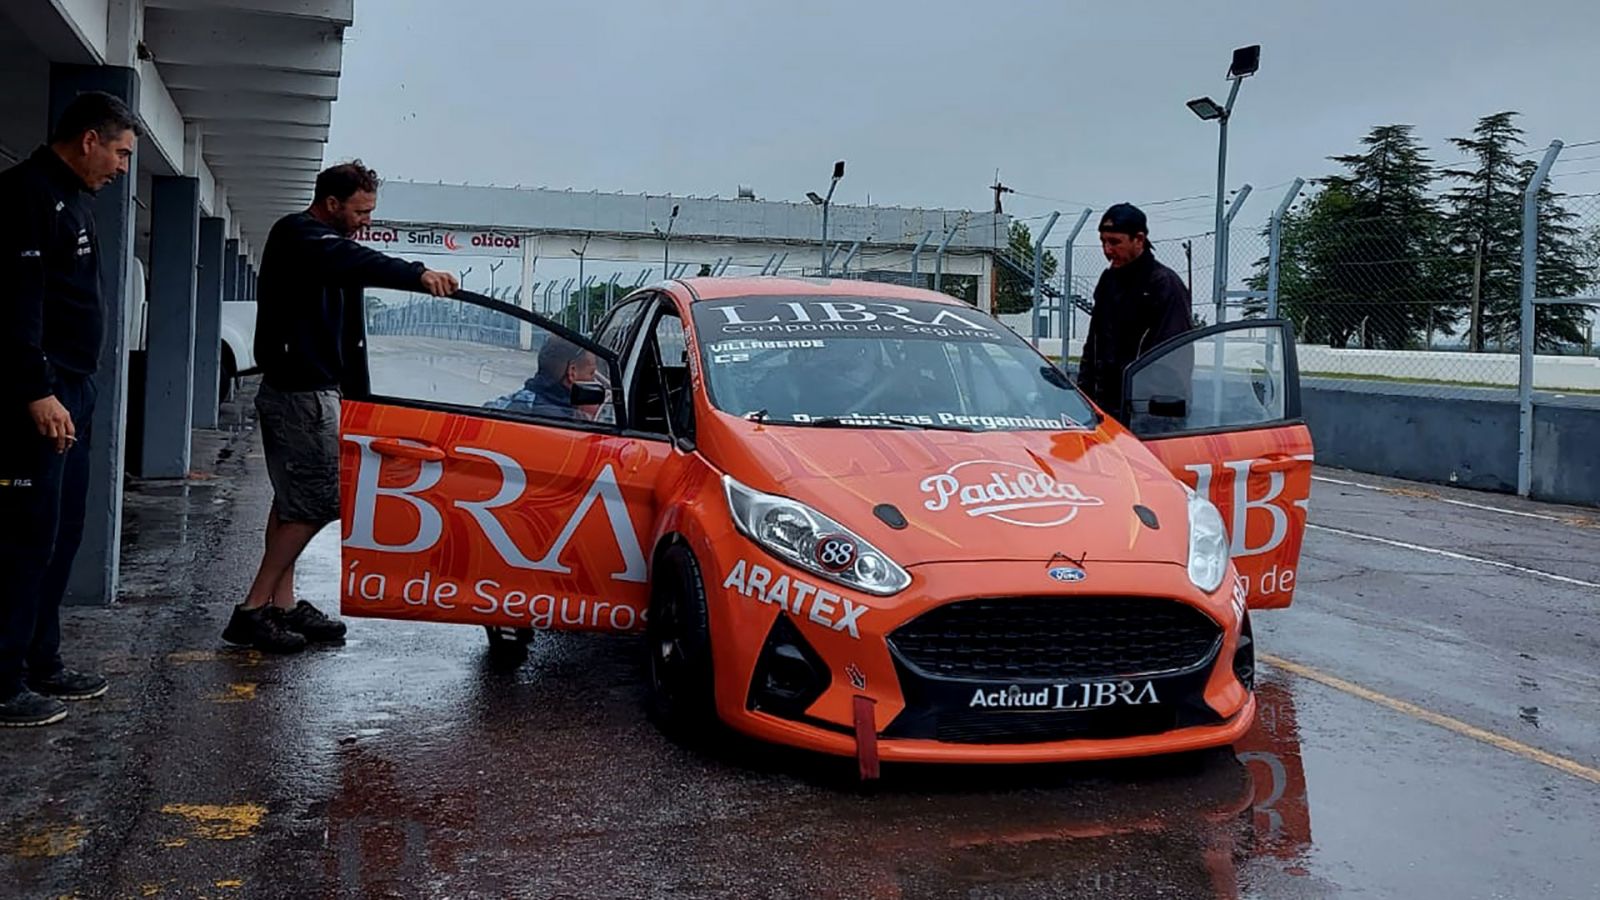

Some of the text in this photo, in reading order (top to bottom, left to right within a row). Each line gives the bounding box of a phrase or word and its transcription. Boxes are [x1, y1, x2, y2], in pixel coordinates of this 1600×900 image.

[471, 234, 520, 248] olicol
[709, 302, 993, 331] LIBRA
[867, 323, 896, 333] de
[903, 324, 1001, 340] Seguros
[938, 412, 1063, 429] Pergamino
[920, 470, 1085, 513] Padilla
[821, 541, 853, 565] 88
[403, 571, 458, 609] de
[1261, 565, 1294, 594] de
[723, 559, 869, 639] ARATEX
[969, 681, 1160, 709] Actitud LIBRA
